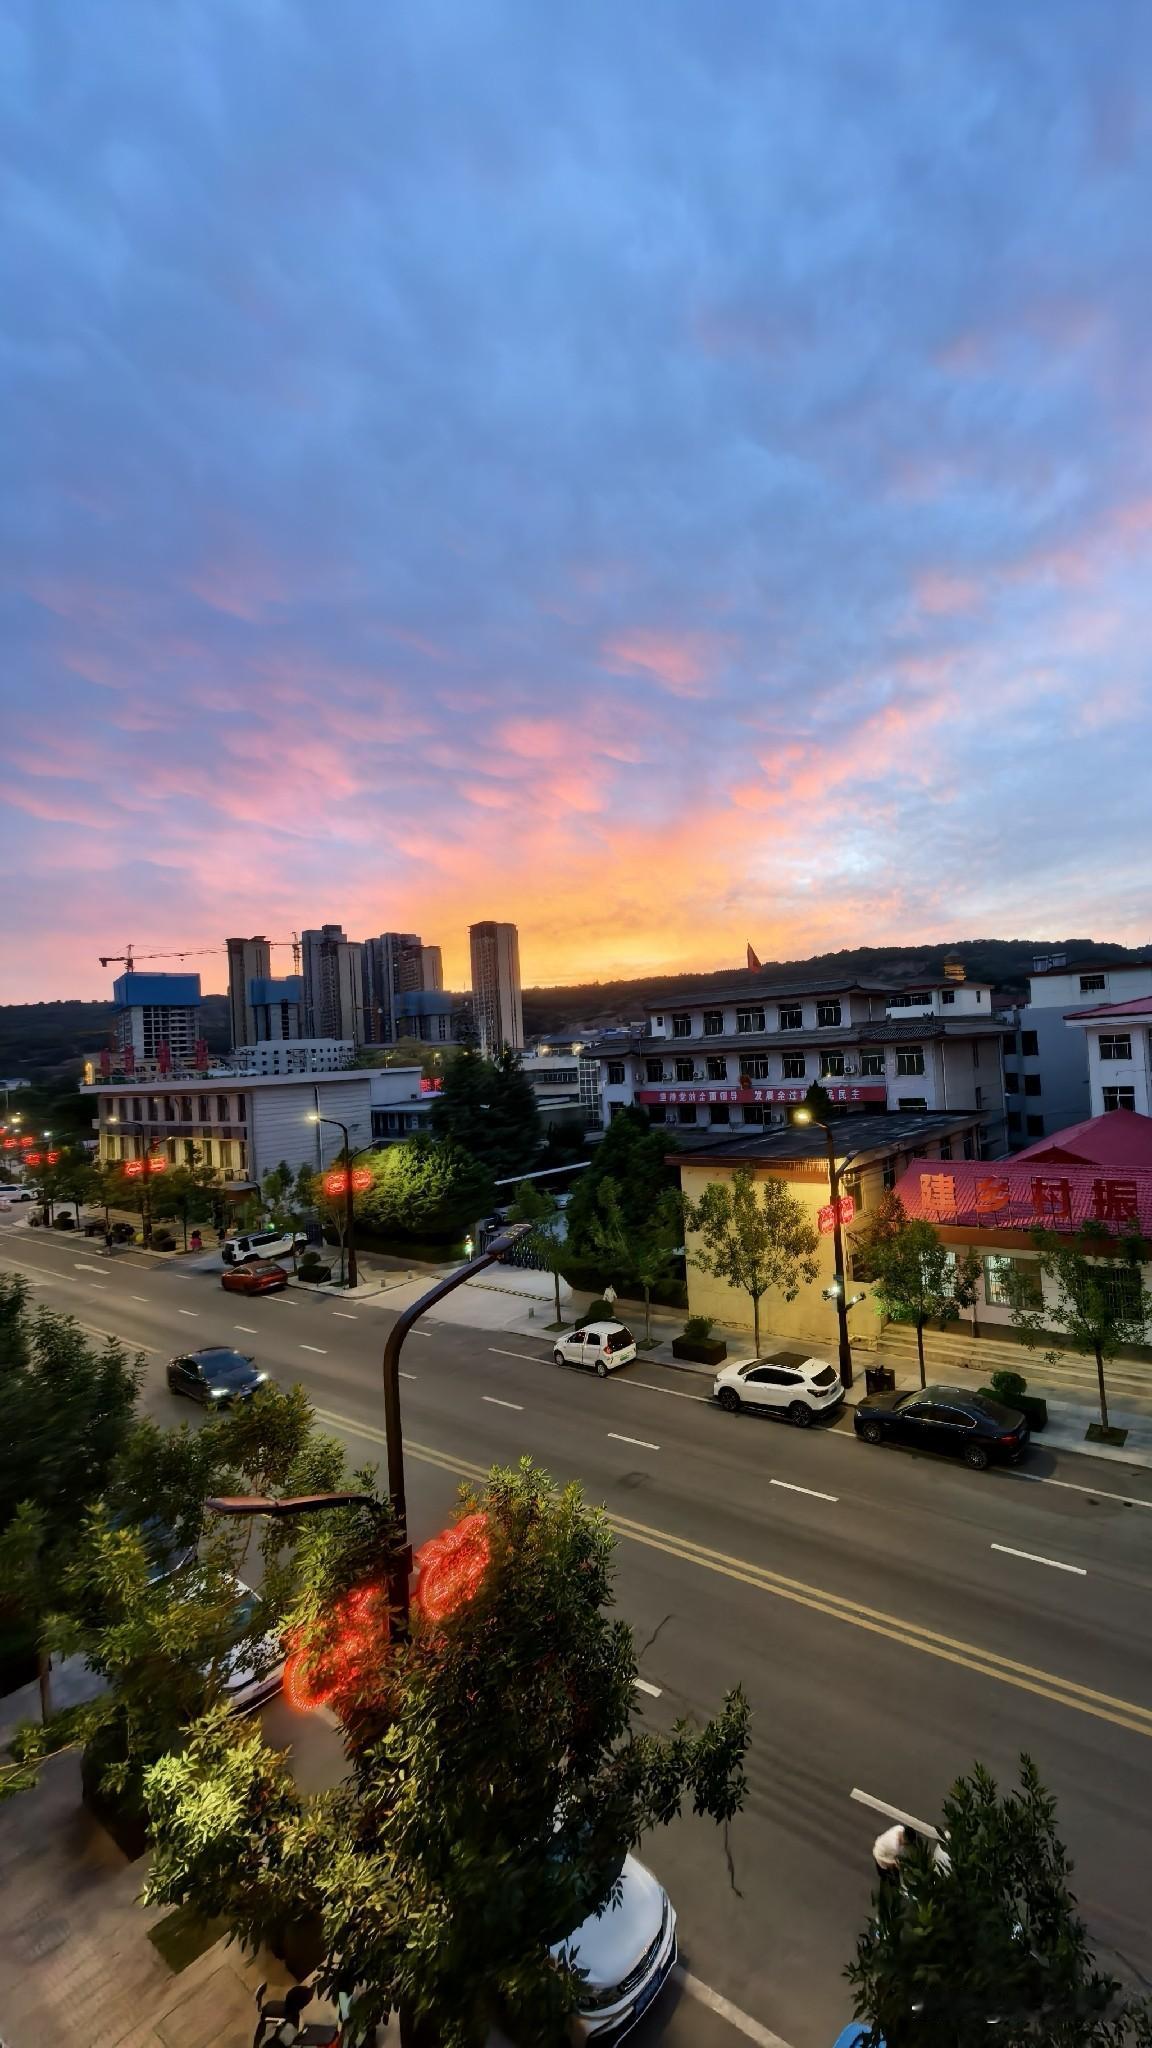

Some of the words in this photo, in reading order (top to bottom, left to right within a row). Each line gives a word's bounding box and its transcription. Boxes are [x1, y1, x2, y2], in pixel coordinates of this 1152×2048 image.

[754, 1089, 860, 1101] 发展全过程民民主
